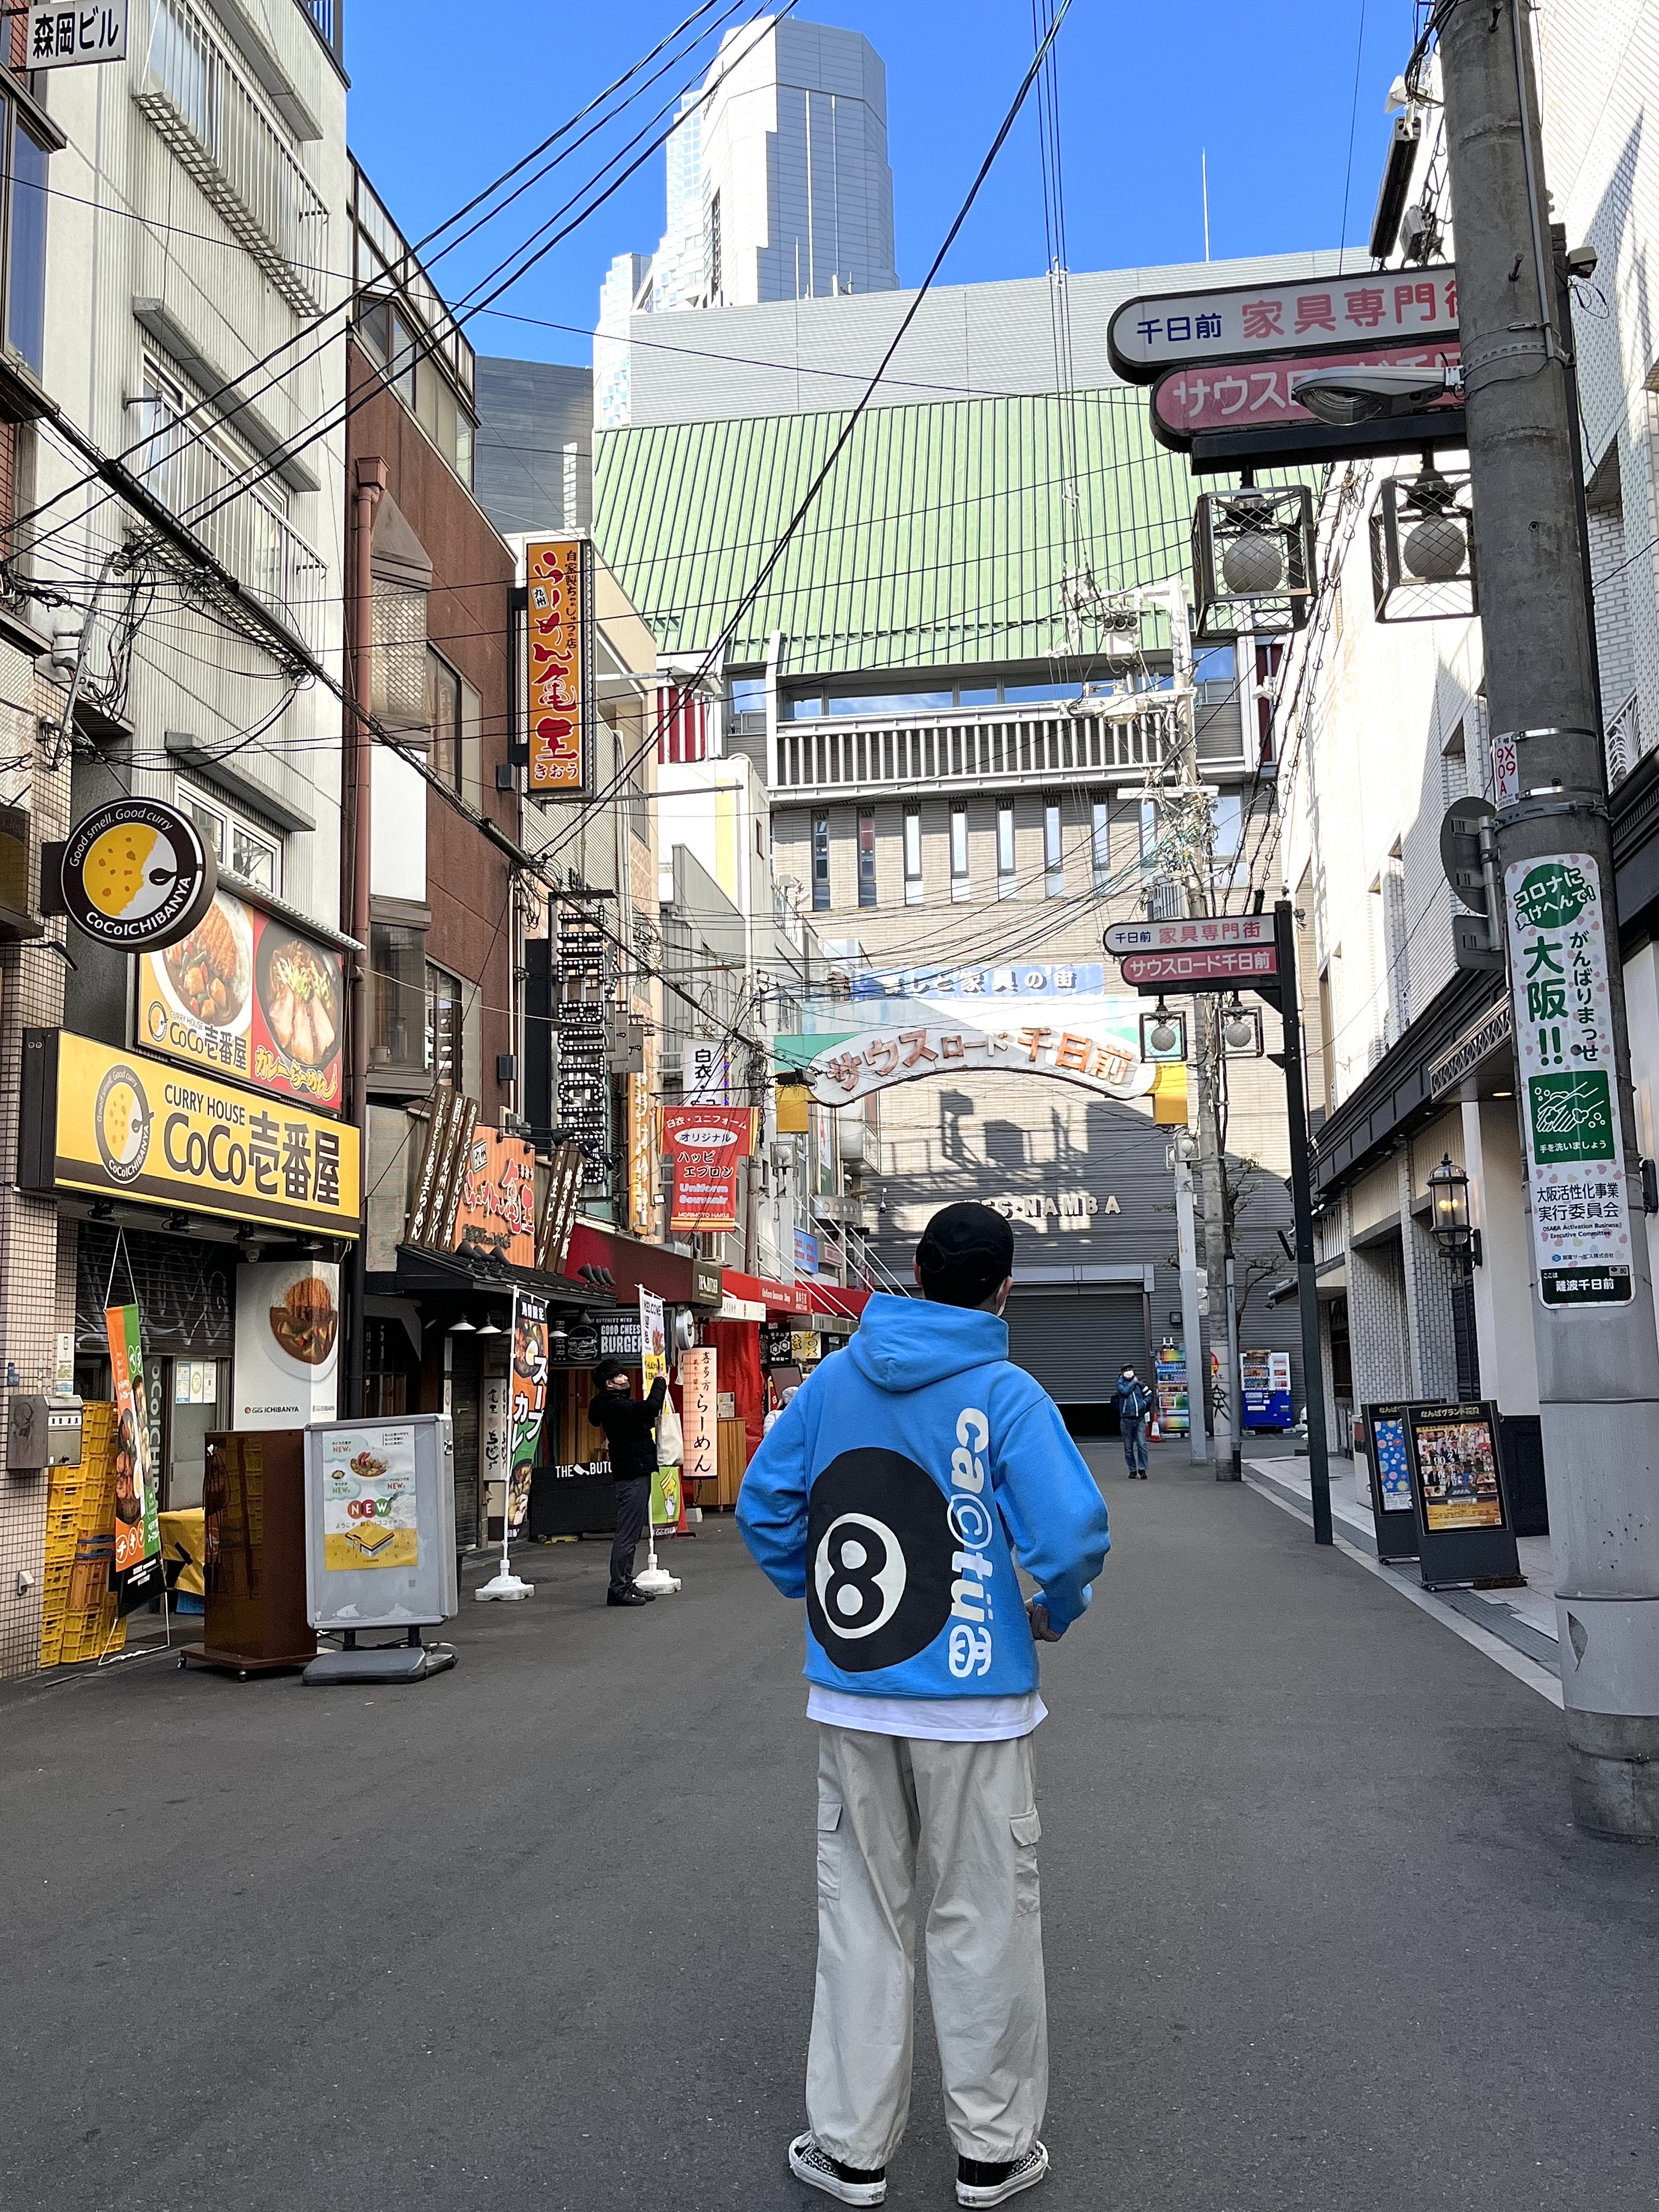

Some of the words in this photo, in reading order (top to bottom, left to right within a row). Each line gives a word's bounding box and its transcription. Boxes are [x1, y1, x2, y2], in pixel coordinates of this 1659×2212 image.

[33, 6, 119, 59] 森岡ビル
[1137, 313, 1222, 344] 千日前
[533, 588, 548, 607] 九州
[534, 764, 578, 780] きおう
[1500, 781, 1506, 795] A
[70, 835, 88, 866] Good
[87, 813, 115, 839] smell.
[116, 808, 146, 820] Good
[146, 812, 173, 831] curry
[1514, 868, 1584, 908] コロナに
[86, 877, 191, 935] CoCoICHIBANYA
[557, 905, 605, 984] THE
[1115, 932, 1151, 944] 千日前
[1159, 922, 1260, 944] 家具専門街
[1130, 952, 1269, 978] サウスロード千日前
[1570, 931, 1599, 1062] がんばりまっせ
[170, 1011, 185, 1024] CURRY
[187, 1015, 203, 1030] HOUSE
[170, 1022, 246, 1070] CoCo壱番屋
[827, 1026, 1133, 1091] サウスロード千日前
[255, 1046, 337, 1099] カレーらーめん
[165, 1085, 203, 1114] CURRY
[207, 1098, 245, 1126] HOUSE
[667, 1115, 747, 1129] 白衣・ユニフォーム
[681, 1133, 731, 1142] オリジナル
[1539, 1139, 1606, 1154] 手を洗いましょう
[164, 1111, 340, 1206] CoCo壱番屋
[678, 1151, 715, 1163] ハッピ
[684, 1166, 733, 1178] エプロン
[679, 1183, 728, 1193] Uniform
[679, 1195, 728, 1204] Souvenir
[1536, 1182, 1619, 1203] 大阪活性化事業
[1538, 1202, 1619, 1222] 実行委員会
[1556, 1278, 1614, 1291] 難波千日前
[555, 1321, 565, 1355] BUGER
[601, 1324, 618, 1335] GOOD
[620, 1324, 641, 1335] CHEES
[701, 1351, 712, 1391] 喜多方
[526, 1356, 548, 1440] スープ
[694, 1393, 711, 1472] らーめん
[555, 1464, 574, 1478] THE
[351, 1503, 388, 1515] NEW
[117, 1528, 144, 1559] チキン
[825, 1522, 887, 1629] 8
